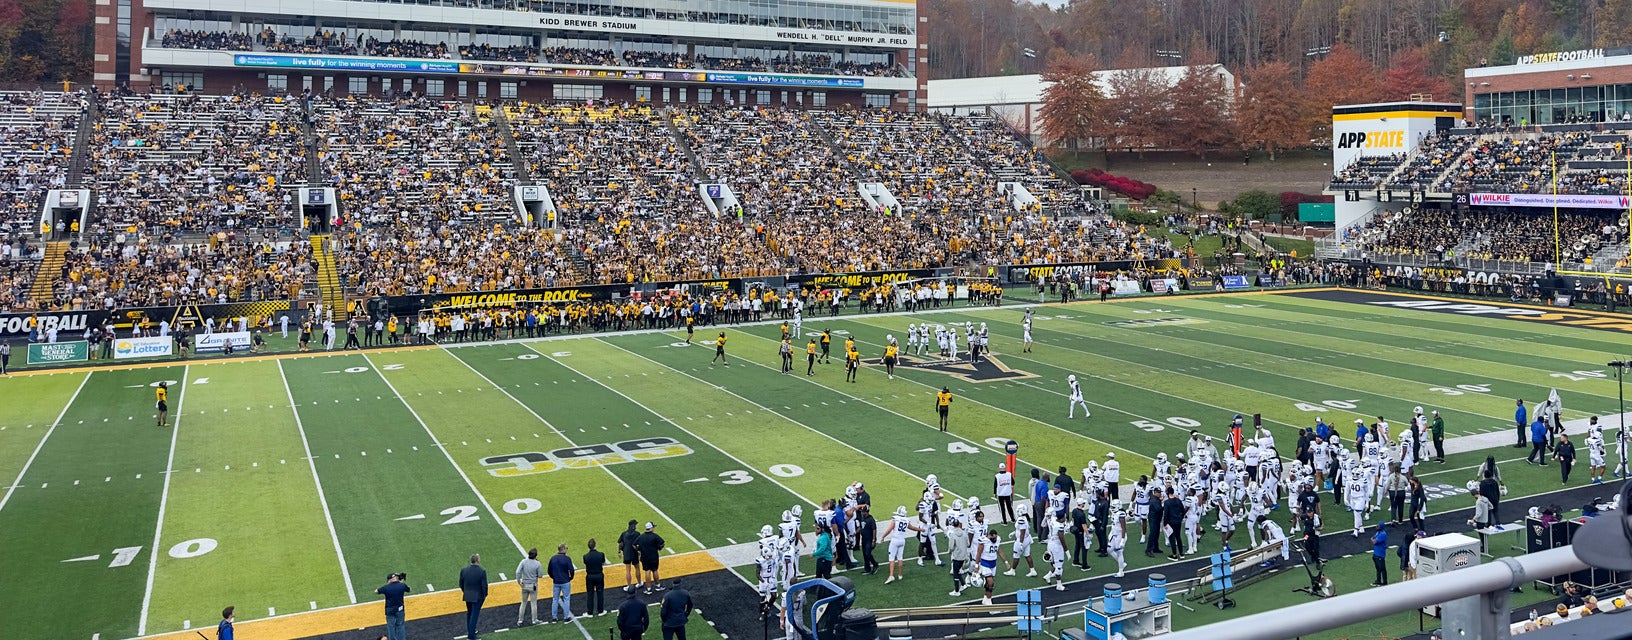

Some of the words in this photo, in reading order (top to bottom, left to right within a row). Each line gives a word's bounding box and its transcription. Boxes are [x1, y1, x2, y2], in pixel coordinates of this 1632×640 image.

[540, 17, 560, 25] KIDD
[564, 19, 598, 28] BREWER
[602, 21, 637, 30] STADIUM
[777, 31, 809, 40] WENDELL
[821, 34, 844, 42] "DELL"
[308, 58, 326, 67] fully
[350, 60, 376, 69] winning
[1456, 194, 1467, 203] 26
[1483, 194, 1510, 202] WILKIE
[882, 273, 909, 285] ROCK
[451, 292, 517, 309] WELCOME
[517, 294, 527, 302] TO
[528, 293, 543, 301] THE
[543, 289, 579, 302] ROCK
[0, 314, 88, 334] FOOTBALL
[133, 345, 169, 354] Lottery
[1429, 383, 1491, 396] 30
[1294, 399, 1357, 412] 40
[1129, 416, 1202, 432] 50
[947, 437, 1020, 454] 40
[718, 463, 805, 485] 30
[1350, 484, 1361, 492] 40
[1051, 499, 1060, 508] 70
[439, 497, 542, 525] 20
[788, 528, 794, 537] 7
[897, 521, 908, 533] 92
[108, 537, 218, 568] 10
[767, 564, 772, 574] 5
